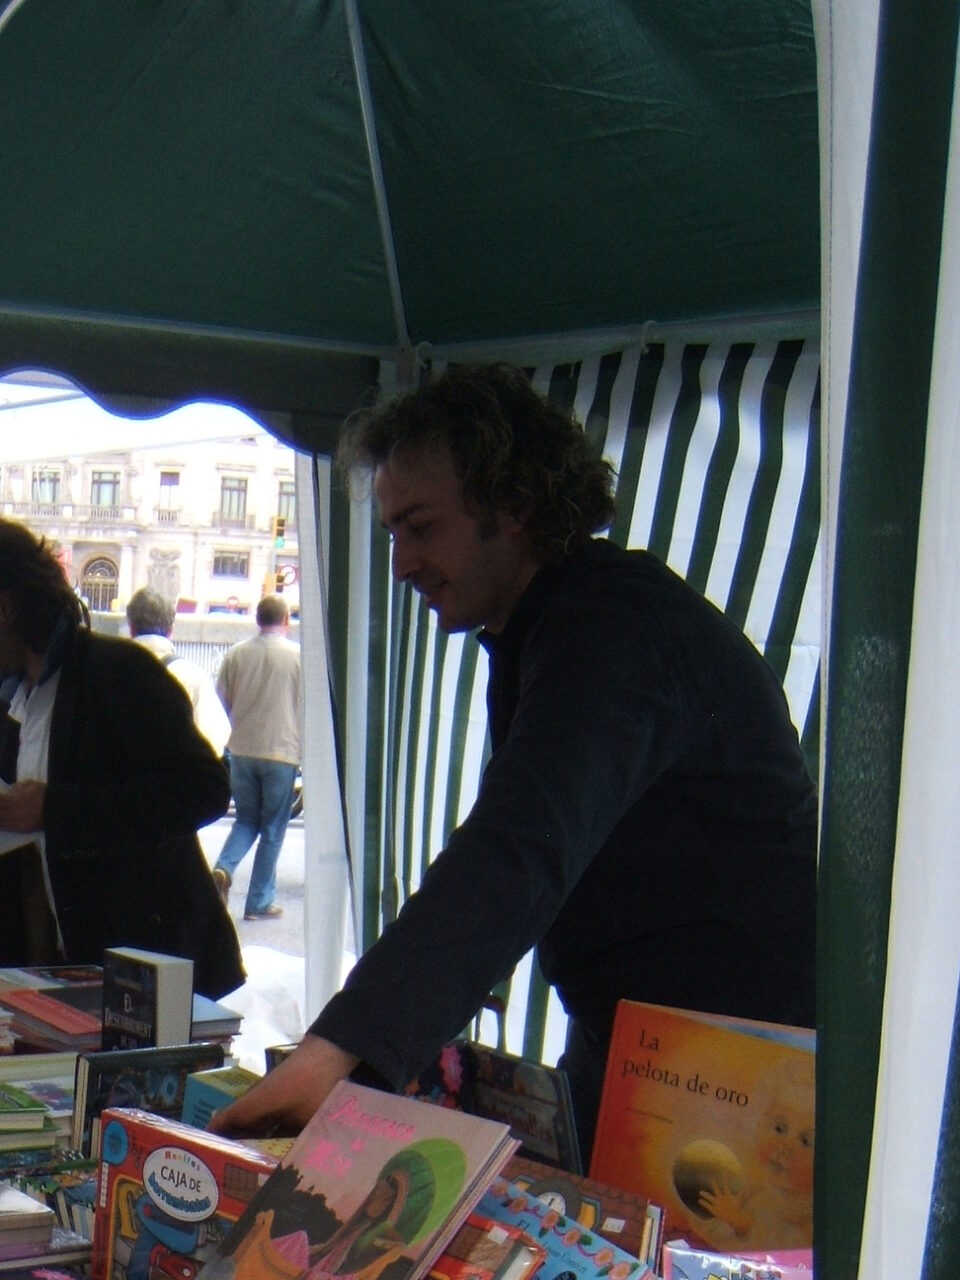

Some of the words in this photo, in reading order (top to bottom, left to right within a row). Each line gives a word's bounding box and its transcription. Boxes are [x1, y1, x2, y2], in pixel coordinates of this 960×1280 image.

[639, 1028, 660, 1051] La
[621, 1059, 680, 1088] pelota
[685, 1072, 710, 1095] de
[714, 1086, 749, 1107] oro
[160, 1166, 188, 1188] CAJA
[189, 1177, 203, 1193] DE
